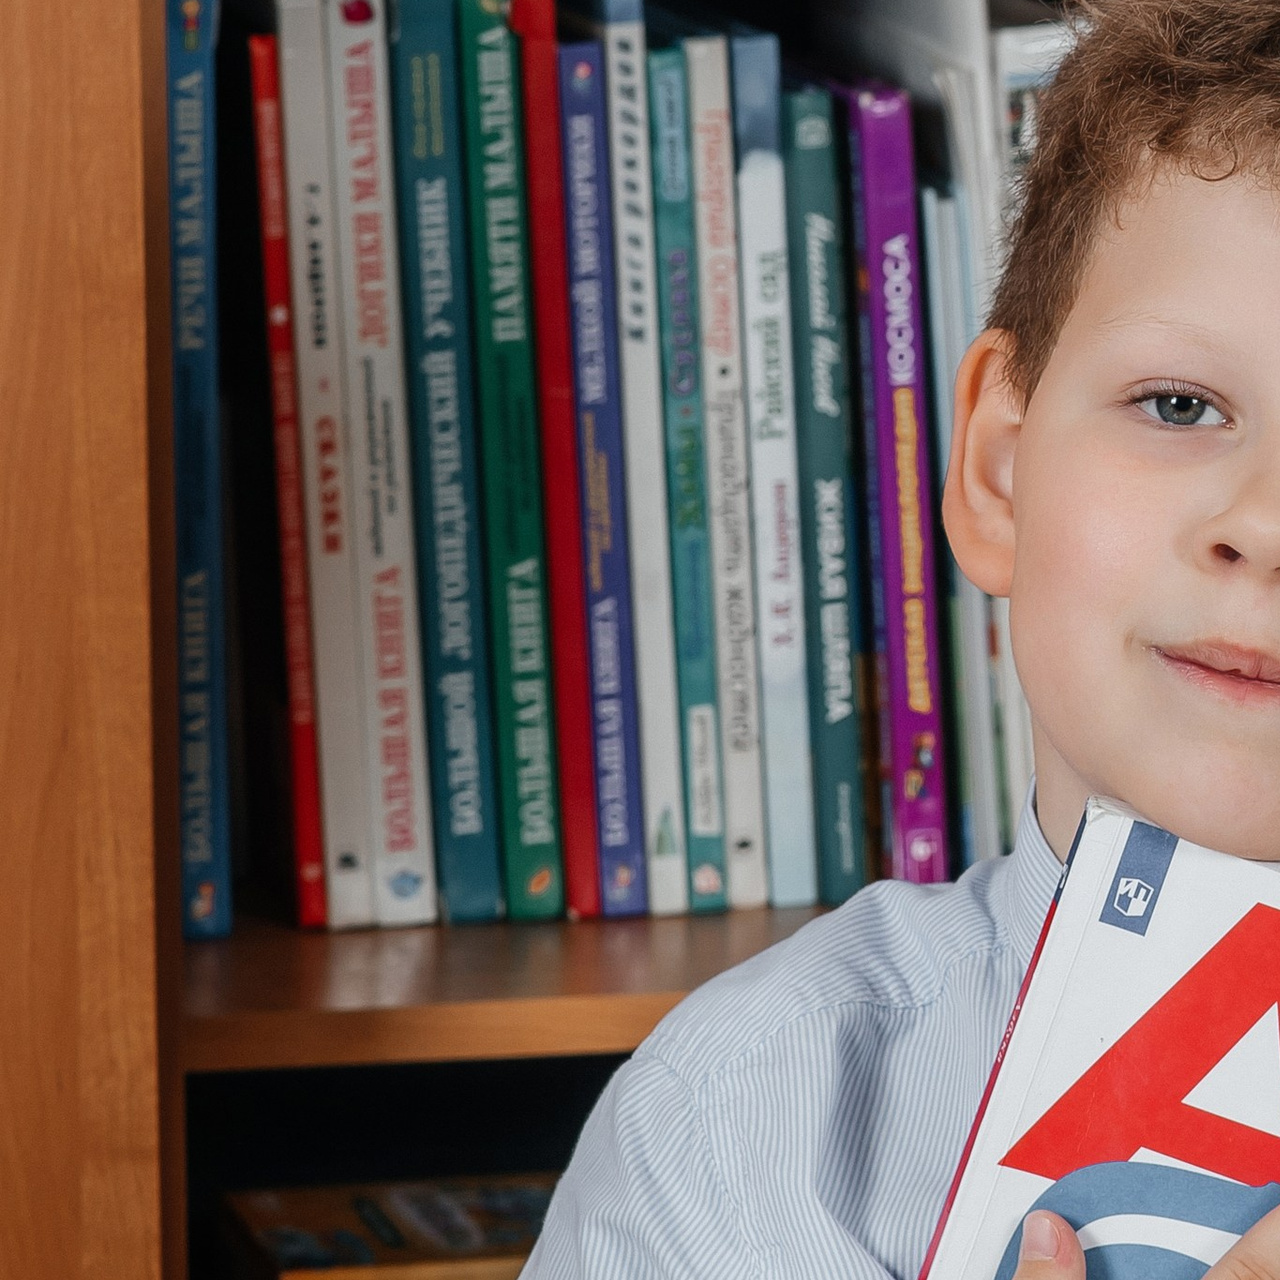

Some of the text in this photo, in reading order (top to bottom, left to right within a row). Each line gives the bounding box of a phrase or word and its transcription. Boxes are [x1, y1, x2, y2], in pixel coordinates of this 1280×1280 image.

[174, 70, 206, 248] МАЛЫША
[343, 37, 383, 204] МАЛЫША
[477, 25, 514, 191] МАЛЫША
[415, 176, 456, 339] УЧЕБНИК
[486, 196, 526, 343] ПАМЯТИ
[567, 114, 600, 276] МОТОРИКИ
[177, 256, 207, 350] РЕЧИ
[352, 212, 391, 348] ЛОГИКИ
[571, 278, 608, 404] МЕЛКОЙ
[882, 233, 917, 387] КОСМОСА
[422, 350, 474, 661] ЛОГОПЕДИЧЕСКИЙ
[372, 566, 409, 679] КНИГА
[506, 556, 544, 673] КНИГА
[590, 596, 623, 694] КНИГА
[813, 478, 853, 724] ЖИВАЯ ШЛЯПА
[378, 686, 418, 854] БОЛЬШАЯ
[437, 672, 480, 836] БОЛЬШОЙ
[512, 679, 555, 846] БОЛЬШАЯ
[595, 698, 630, 847] БОЛЬШАЯ
